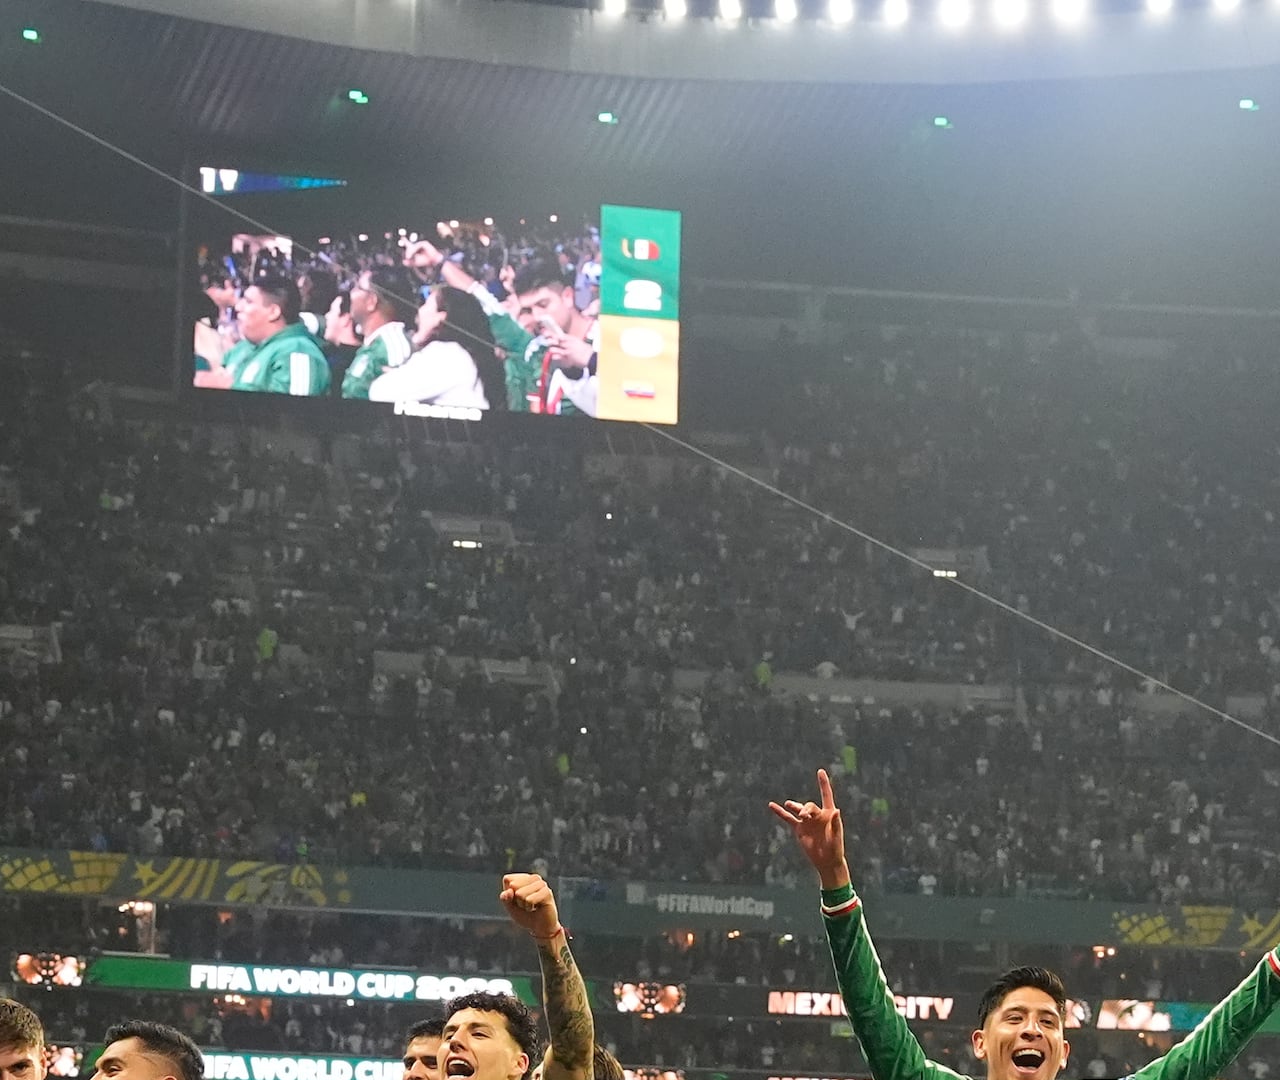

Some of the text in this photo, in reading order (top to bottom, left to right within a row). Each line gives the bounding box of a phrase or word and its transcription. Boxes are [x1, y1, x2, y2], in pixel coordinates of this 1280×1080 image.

[657, 894, 774, 918] #FIFAWorldCup
[190, 964, 253, 992] FIFA
[253, 968, 355, 997] WORLD
[357, 973, 415, 1000] CUP
[768, 991, 847, 1017] MEXI
